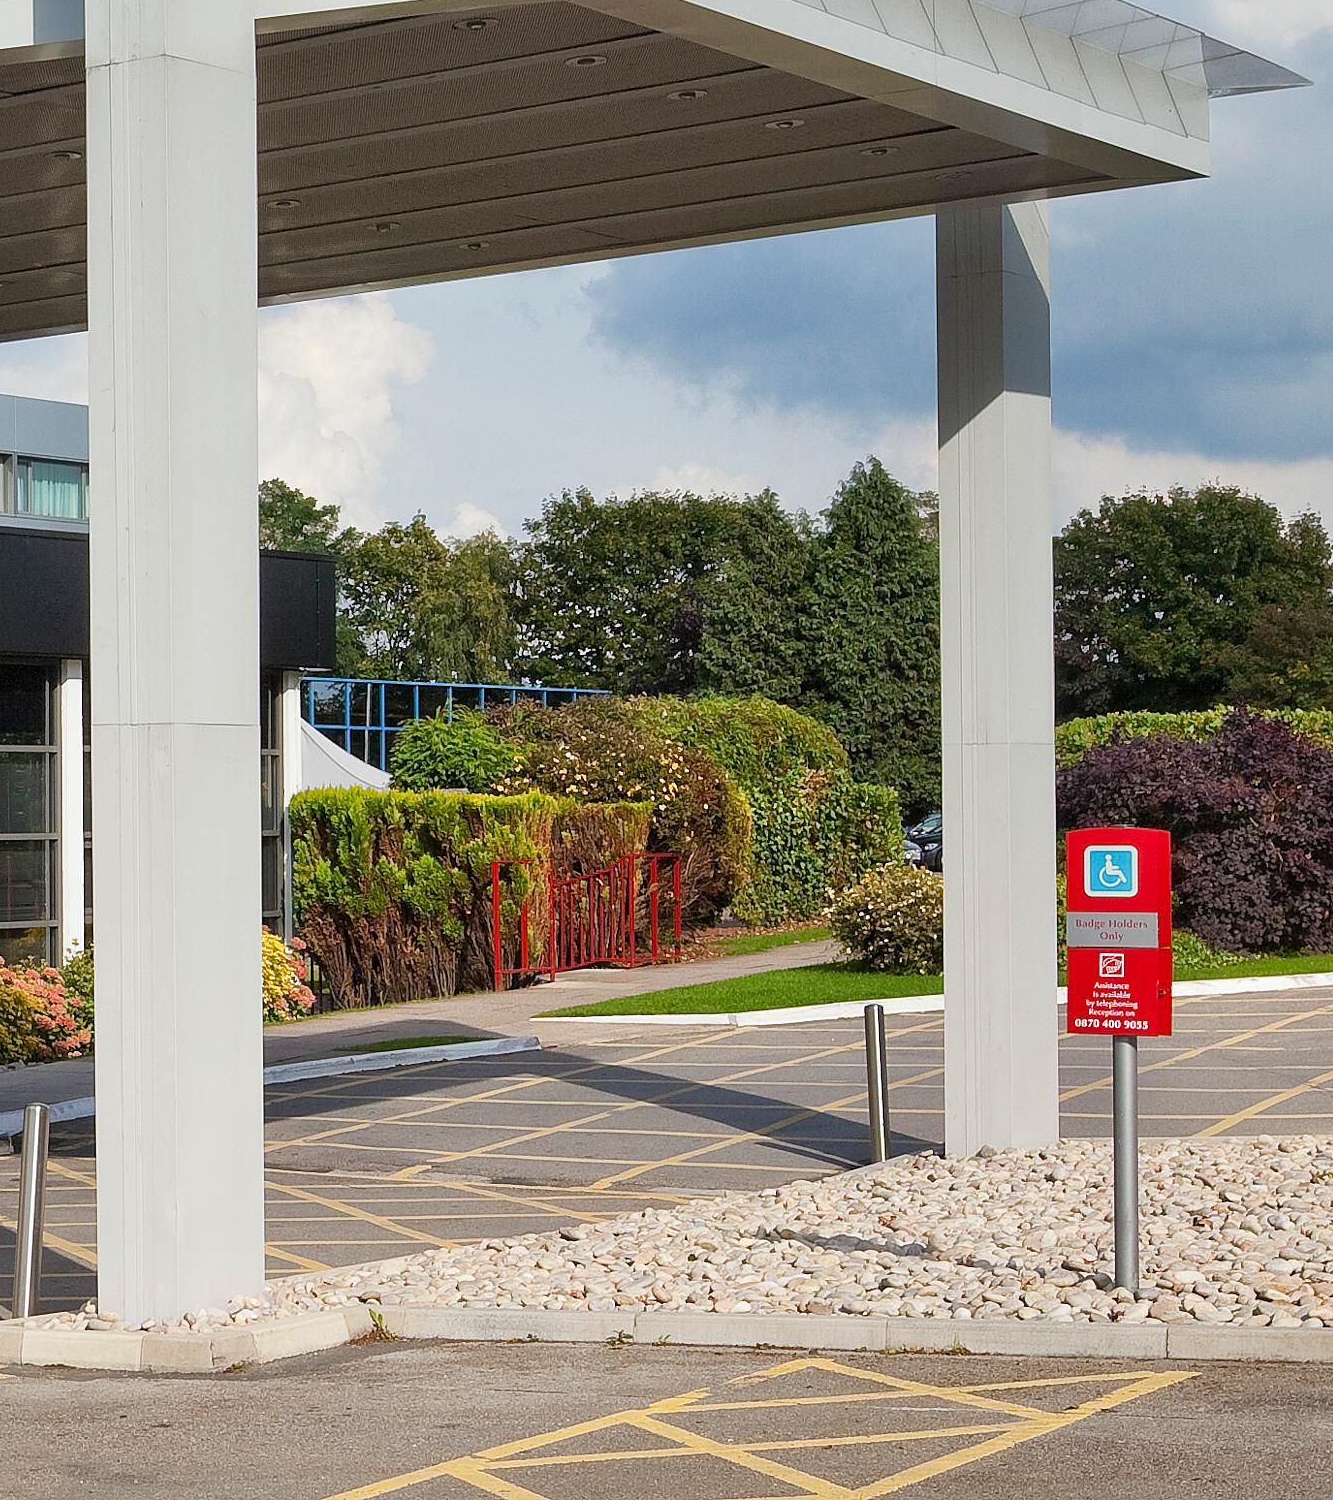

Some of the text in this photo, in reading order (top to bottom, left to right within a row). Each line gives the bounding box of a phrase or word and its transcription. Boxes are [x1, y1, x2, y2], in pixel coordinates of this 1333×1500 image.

[1076, 919, 1148, 930] Badge Holders
[1100, 932, 1124, 942] Only
[1086, 999, 1138, 1009] by telephoning
[1088, 1008, 1124, 1018] Reception
[1074, 1018, 1100, 1028] 0870
[1102, 1019, 1122, 1029] 400
